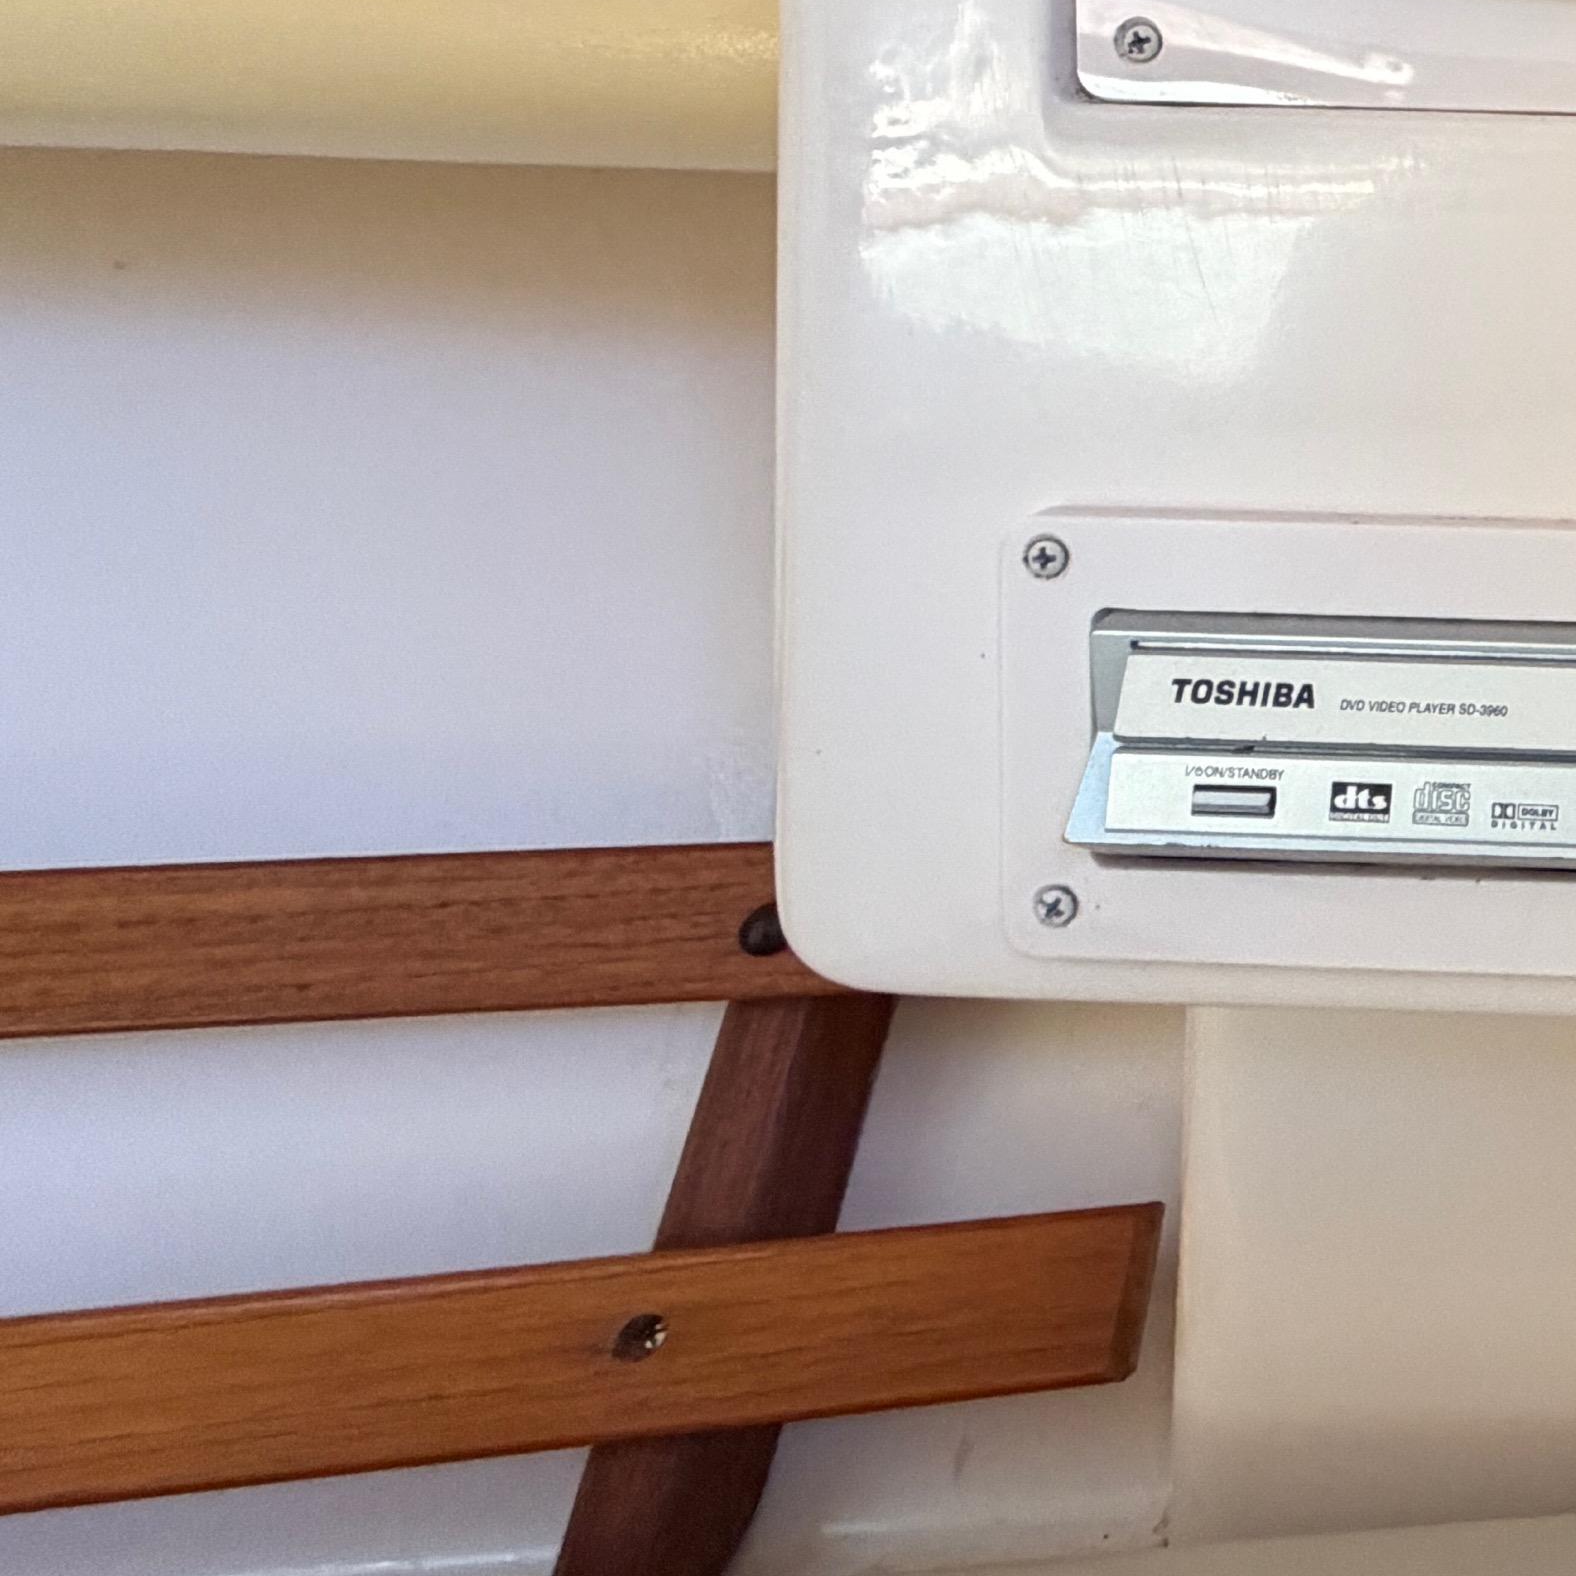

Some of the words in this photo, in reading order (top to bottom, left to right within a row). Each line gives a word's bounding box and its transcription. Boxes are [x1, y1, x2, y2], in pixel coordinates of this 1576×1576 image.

[1171, 678, 1315, 709] TOSHIBA
[1340, 698, 1365, 712] DVD
[1368, 699, 1405, 714] VIDEO
[1408, 701, 1456, 716] PLAYER
[1334, 785, 1387, 810] dts
[1414, 781, 1471, 811] disc
[1521, 807, 1554, 817] DOLBY
[1491, 819, 1557, 831] DIGITAL
